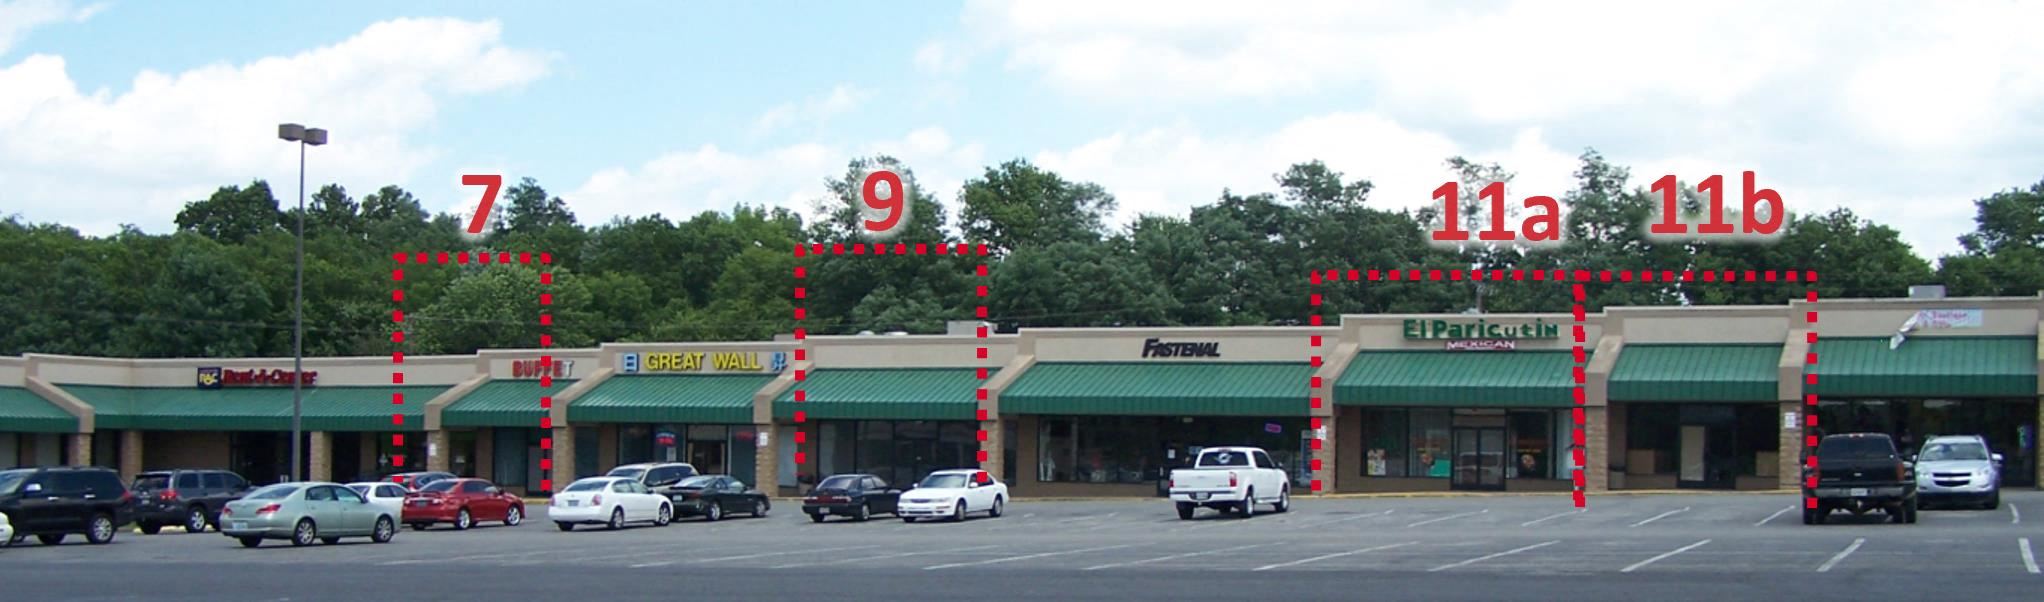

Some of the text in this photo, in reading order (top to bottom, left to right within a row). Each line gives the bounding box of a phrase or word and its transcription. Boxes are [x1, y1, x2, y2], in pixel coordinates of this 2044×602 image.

[1403, 319, 1426, 337] El
[1142, 338, 1221, 358] FASTENAL
[1447, 340, 1515, 350] MEXICAN
[645, 351, 704, 370] GREAT
[712, 352, 762, 371] WALL
